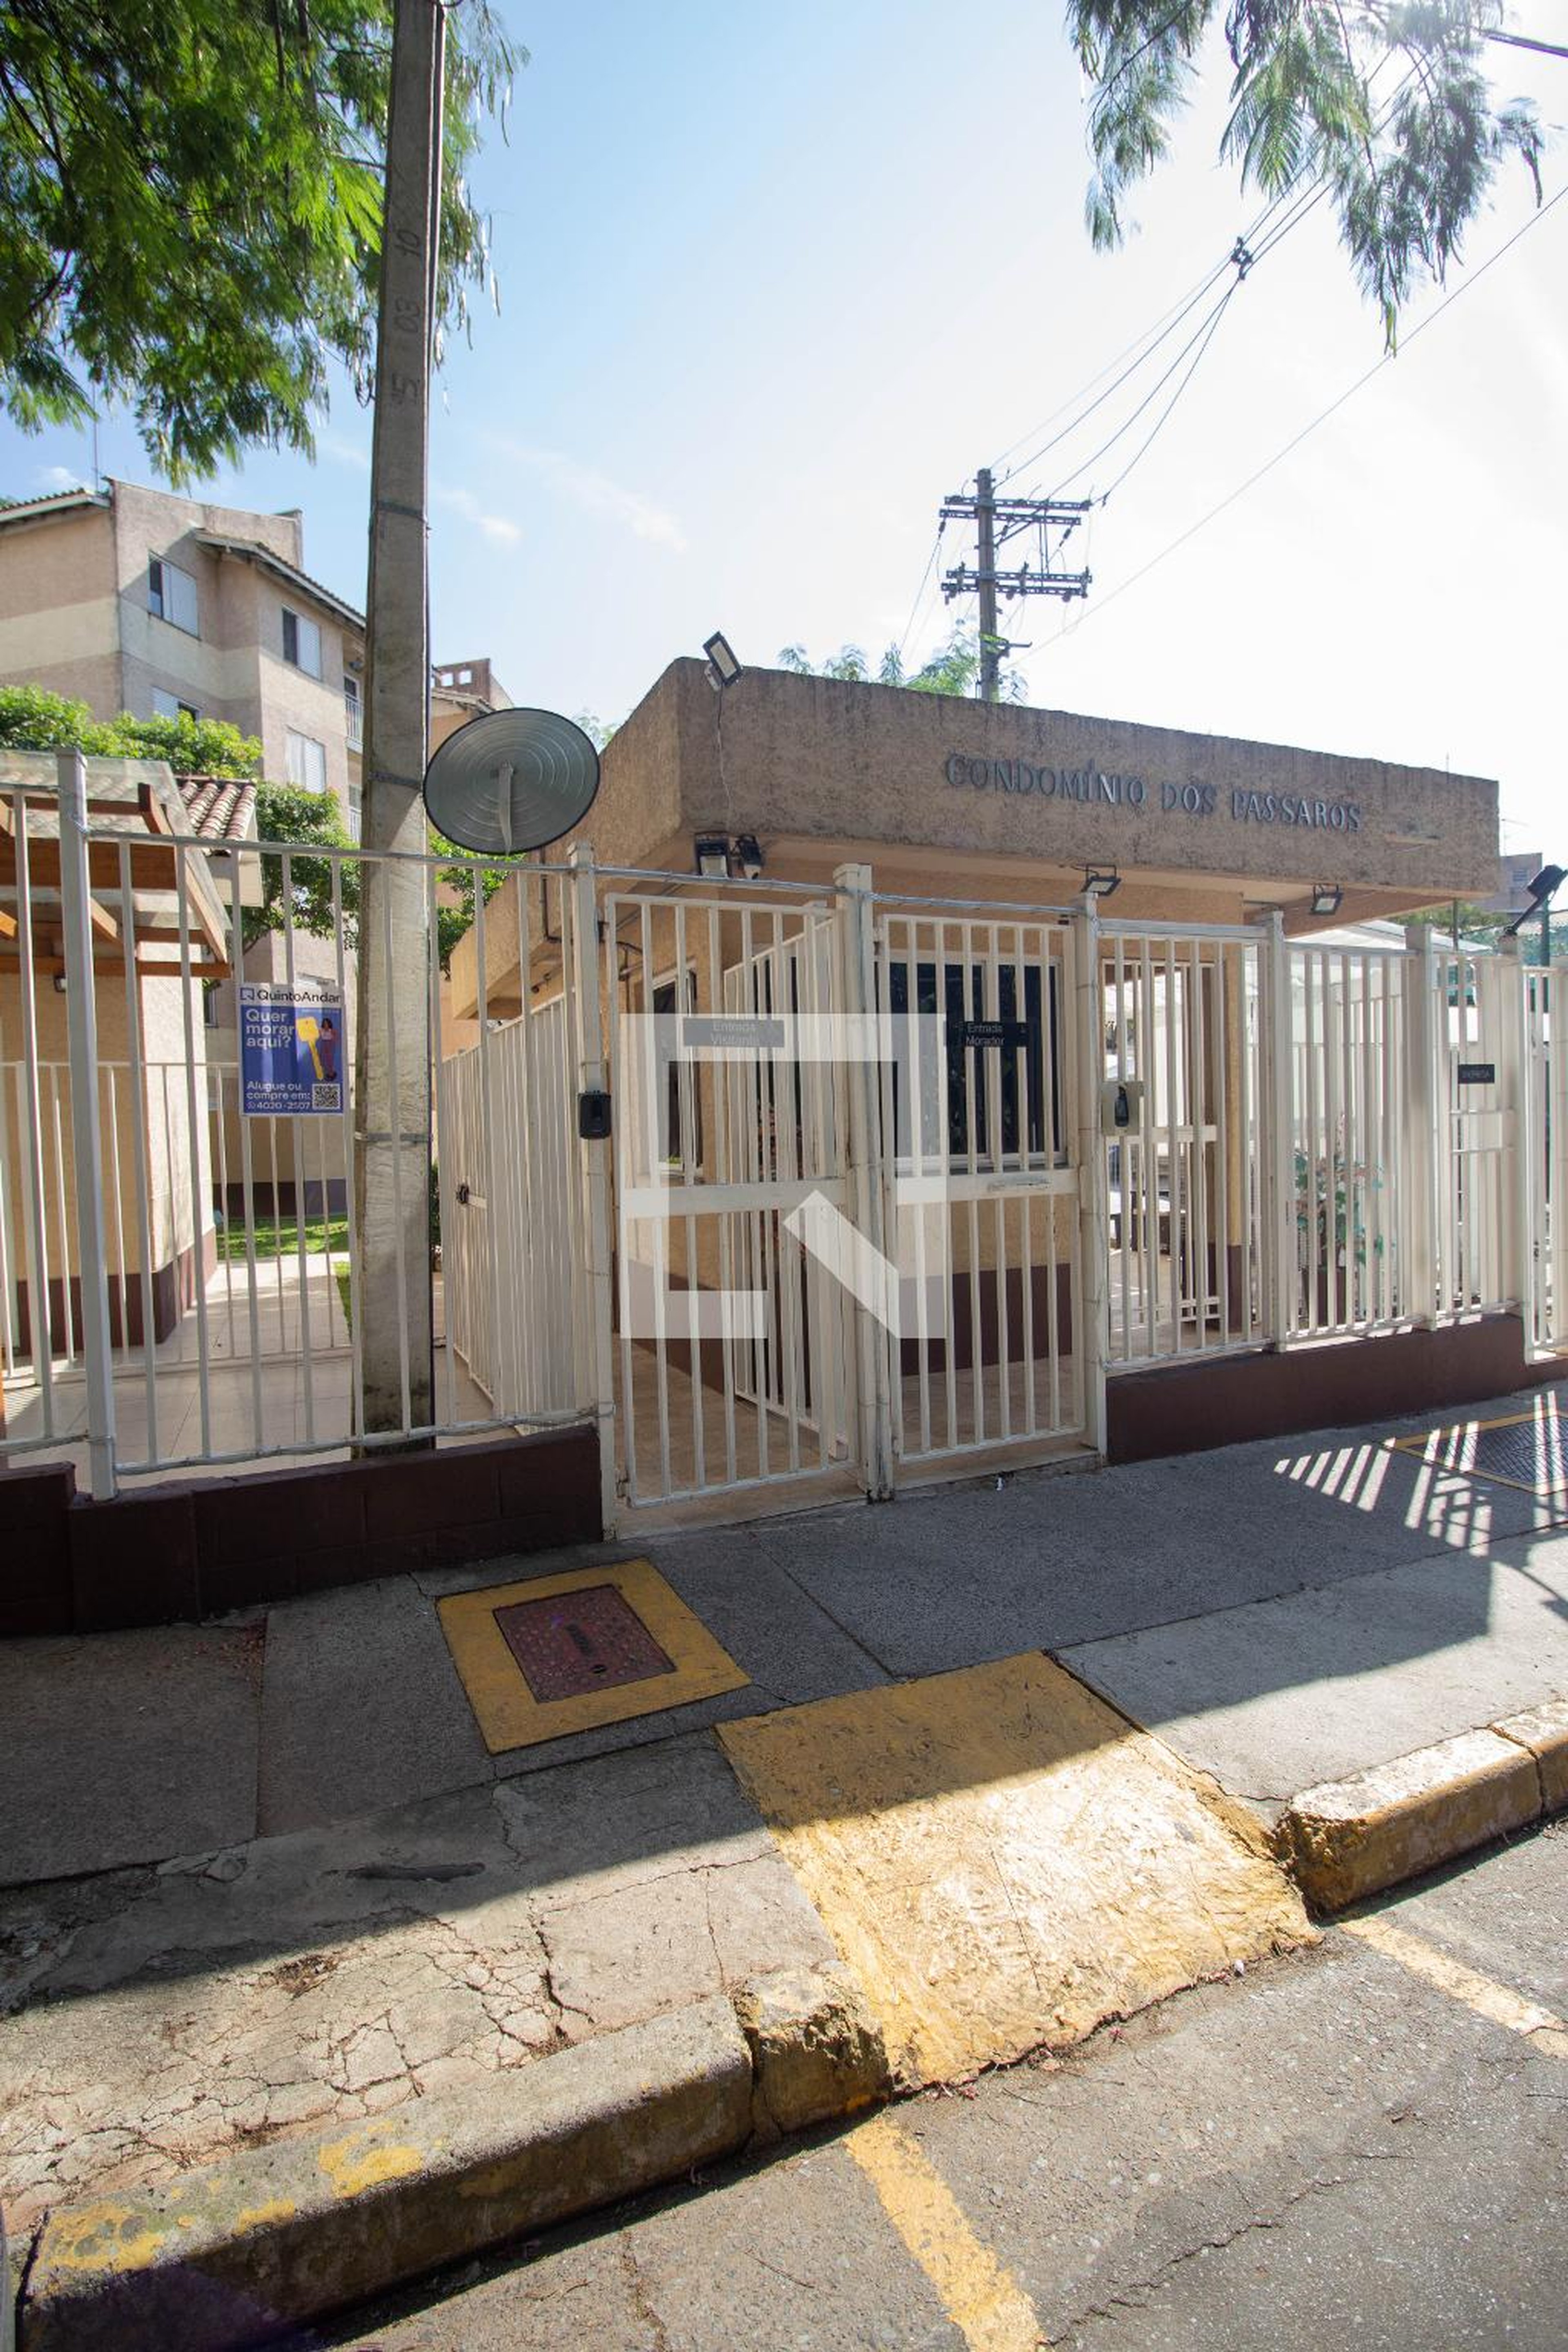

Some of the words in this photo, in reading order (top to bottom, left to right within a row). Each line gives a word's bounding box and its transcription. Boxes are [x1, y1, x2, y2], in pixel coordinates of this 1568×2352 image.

[945, 753, 1147, 807] CONDOMÍNIO
[1162, 782, 1217, 814] DOS
[257, 989, 341, 1003] QuintoAndar
[246, 1009, 286, 1022] Quer
[246, 1025, 294, 1034] morar
[967, 1023, 1003, 1033] Entrada
[246, 1036, 291, 1050] aqui?
[966, 1035, 1005, 1046] Morador
[247, 1081, 285, 1092] Alugue
